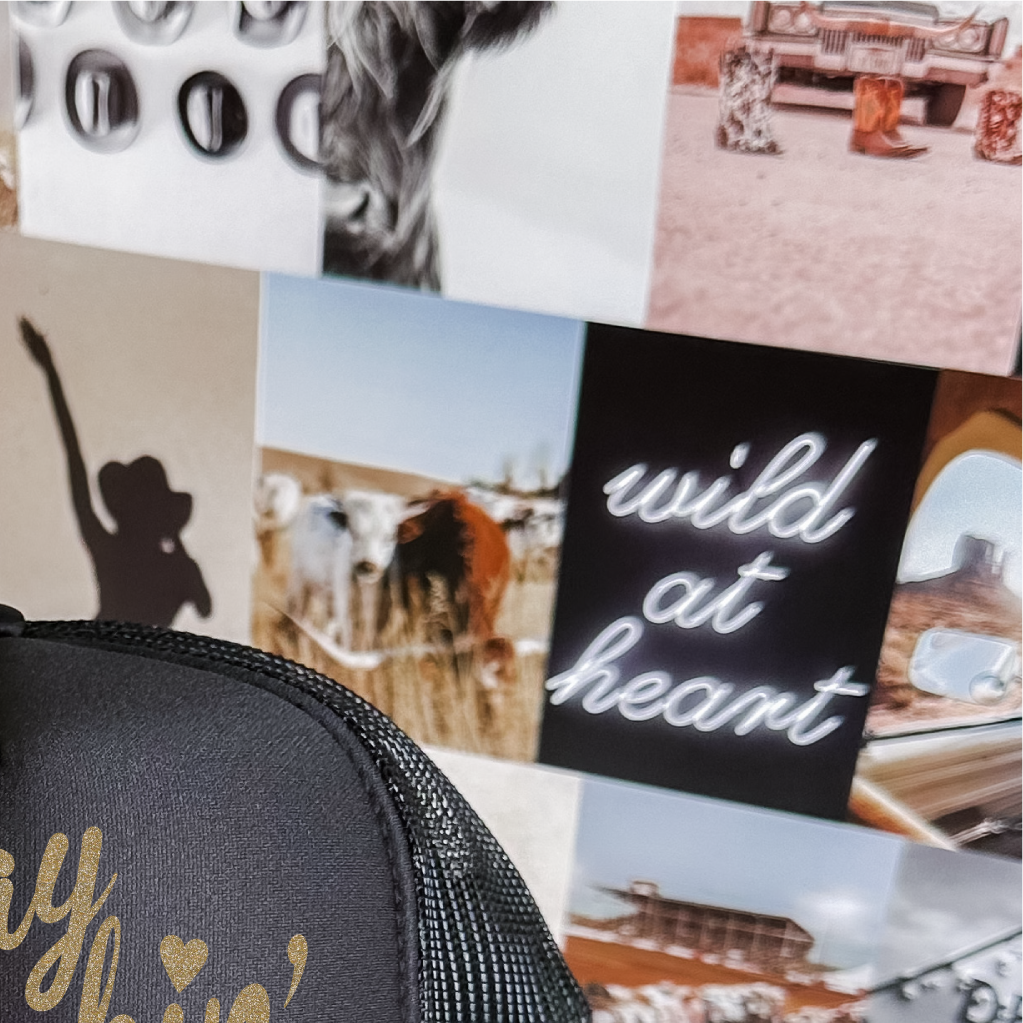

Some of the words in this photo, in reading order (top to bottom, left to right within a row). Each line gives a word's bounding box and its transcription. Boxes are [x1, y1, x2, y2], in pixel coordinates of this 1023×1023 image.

[603, 431, 877, 543] wild
[642, 551, 791, 634] at
[545, 616, 869, 746] heart
